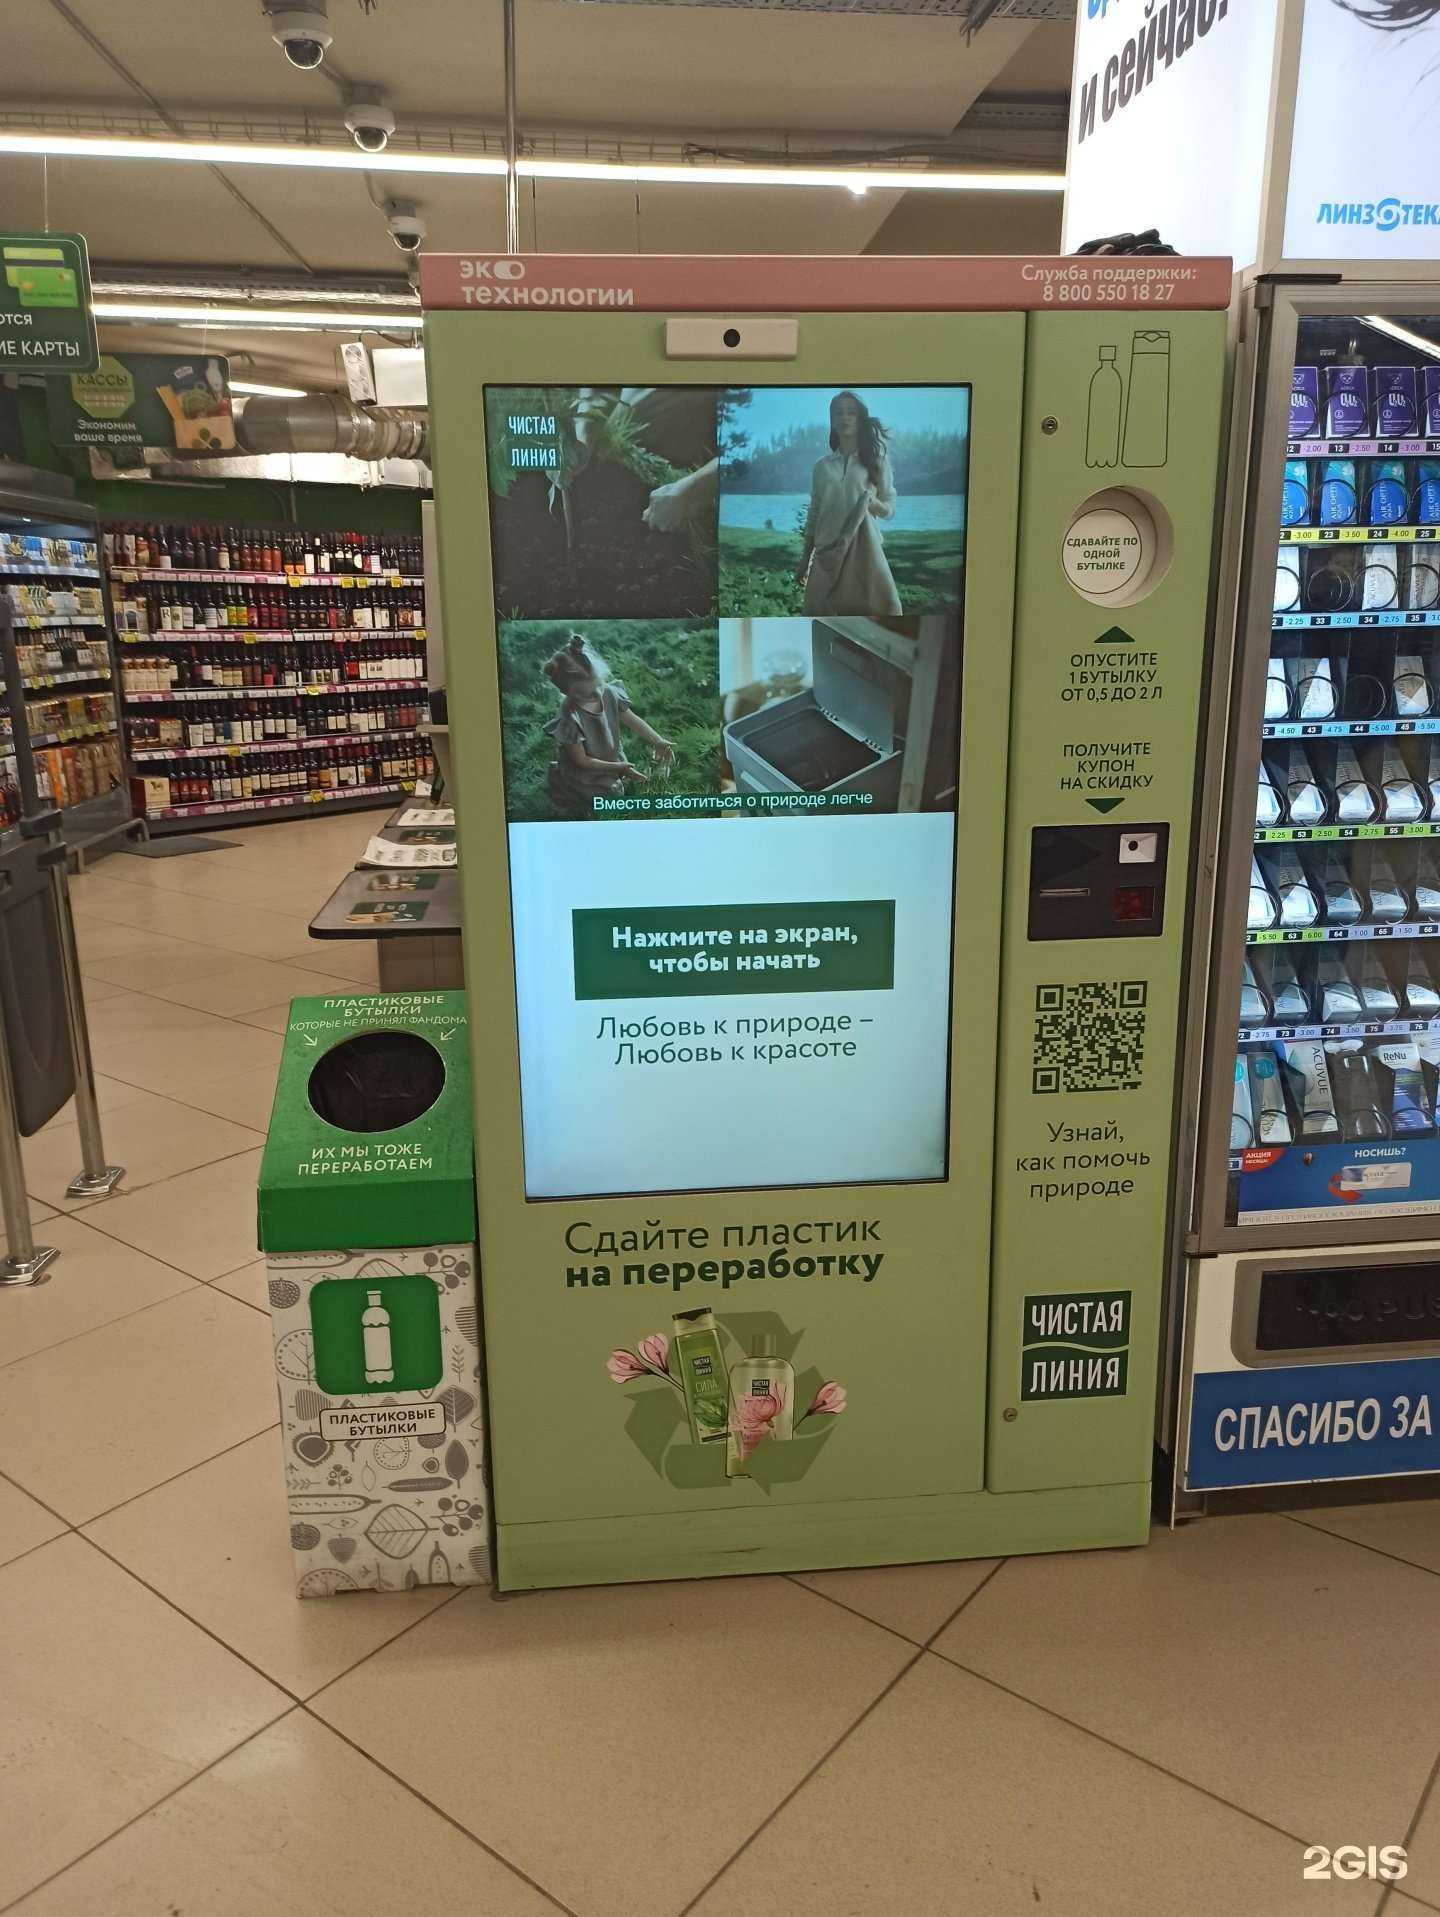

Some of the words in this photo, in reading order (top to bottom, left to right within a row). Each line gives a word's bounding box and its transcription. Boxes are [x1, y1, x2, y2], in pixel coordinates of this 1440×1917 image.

[1079, 73, 1098, 144] и
[1316, 198, 1440, 231] ЛИНЗОТЕК
[1022, 265, 1088, 283] Служба
[1093, 267, 1197, 283] поддержки:
[461, 286, 635, 307] технологии
[1043, 285, 1053, 301] 8
[1059, 285, 1092, 300] 800
[1097, 285, 1126, 300] 550
[1132, 285, 1150, 300] 18
[1155, 284, 1175, 300] 27
[22, 341, 80, 356] КАРТЫ
[78, 374, 127, 386] КАССЫ
[78, 419, 137, 430] Экономим
[508, 416, 555, 435] ЧИСТАЯ
[74, 434, 106, 442] ваше
[108, 434, 143, 444] время
[1334, 444, 1344, 452] 13
[1383, 444, 1393, 452] 14
[511, 448, 556, 467] ЛИНИЯ
[1067, 536, 1121, 547] СДАВАЙТЕ
[1123, 537, 1138, 546] ПО
[1083, 548, 1120, 559] ОДНОЙ
[1077, 561, 1125, 571] БУТЫЛКЕ
[1070, 653, 1158, 667] ОПУСТИТЕ
[1069, 671, 1075, 684] 1
[1080, 669, 1157, 684] БУТЫЛКУ
[1061, 688, 1083, 701] ОТ
[1087, 688, 1107, 703] 0,5
[1111, 686, 1136, 701] ДО
[1140, 687, 1148, 699] 2
[1150, 686, 1162, 699] Л
[1307, 726, 1316, 734] 43
[1063, 742, 1151, 757] ПОЛУЧИТЕ
[1078, 759, 1135, 773] КУПОН
[1061, 777, 1083, 790] НА
[1087, 774, 1154, 790] СКИДКУ
[593, 796, 651, 811] Вместе
[655, 793, 742, 809] заботиться
[747, 796, 756, 807] о
[761, 794, 826, 810] природе
[830, 791, 873, 805] легче
[612, 925, 732, 949] Нажмите
[739, 928, 768, 945] на
[775, 925, 858, 949] экран,
[649, 952, 729, 973] чтобы
[736, 954, 821, 971] начать
[324, 995, 444, 1008] ПЛАСТИКОВЫЕ
[344, 1006, 422, 1017] БУТЫЛКИ
[290, 1020, 341, 1031] КОТОРЫЕ
[343, 1019, 359, 1027] НЕ
[360, 1017, 407, 1026] ПРИНЯЛ
[409, 1016, 467, 1025] ФАНДОМА
[597, 1016, 706, 1040] Любовь
[714, 1019, 727, 1034] к
[736, 1014, 851, 1040] природе
[614, 1041, 722, 1065] Любовь
[732, 1045, 744, 1060] к
[753, 1041, 857, 1065] красоте
[1383, 1051, 1407, 1061] ReNu
[1312, 1047, 1328, 1094] ACUVUE
[1047, 1120, 1124, 1143] Узнай,
[312, 1148, 336, 1159] ИХ
[341, 1145, 369, 1158] МЫ
[374, 1143, 422, 1156] ТОЖЕ
[1355, 1147, 1407, 1158] НОСИШЬ?
[298, 1158, 433, 1176] ПЕРЕРАБОТАЕМ
[1016, 1157, 1055, 1171] как
[1063, 1151, 1150, 1170] помочь
[1030, 1179, 1134, 1202] природе
[565, 1219, 709, 1258] Сдайте
[723, 1220, 882, 1247] пластик
[566, 1265, 611, 1288] на
[623, 1248, 885, 1291] переработку
[1031, 1300, 1123, 1336] ЧИСТАЯ
[1030, 1357, 1120, 1393] ЛИНИЯ
[330, 1409, 436, 1425] ПЛАСТИКОВЫЕ
[1215, 1398, 1381, 1451] СПАСИБО
[1389, 1395, 1432, 1439] ЗА
[350, 1423, 417, 1436] БУТЫЛКИ
